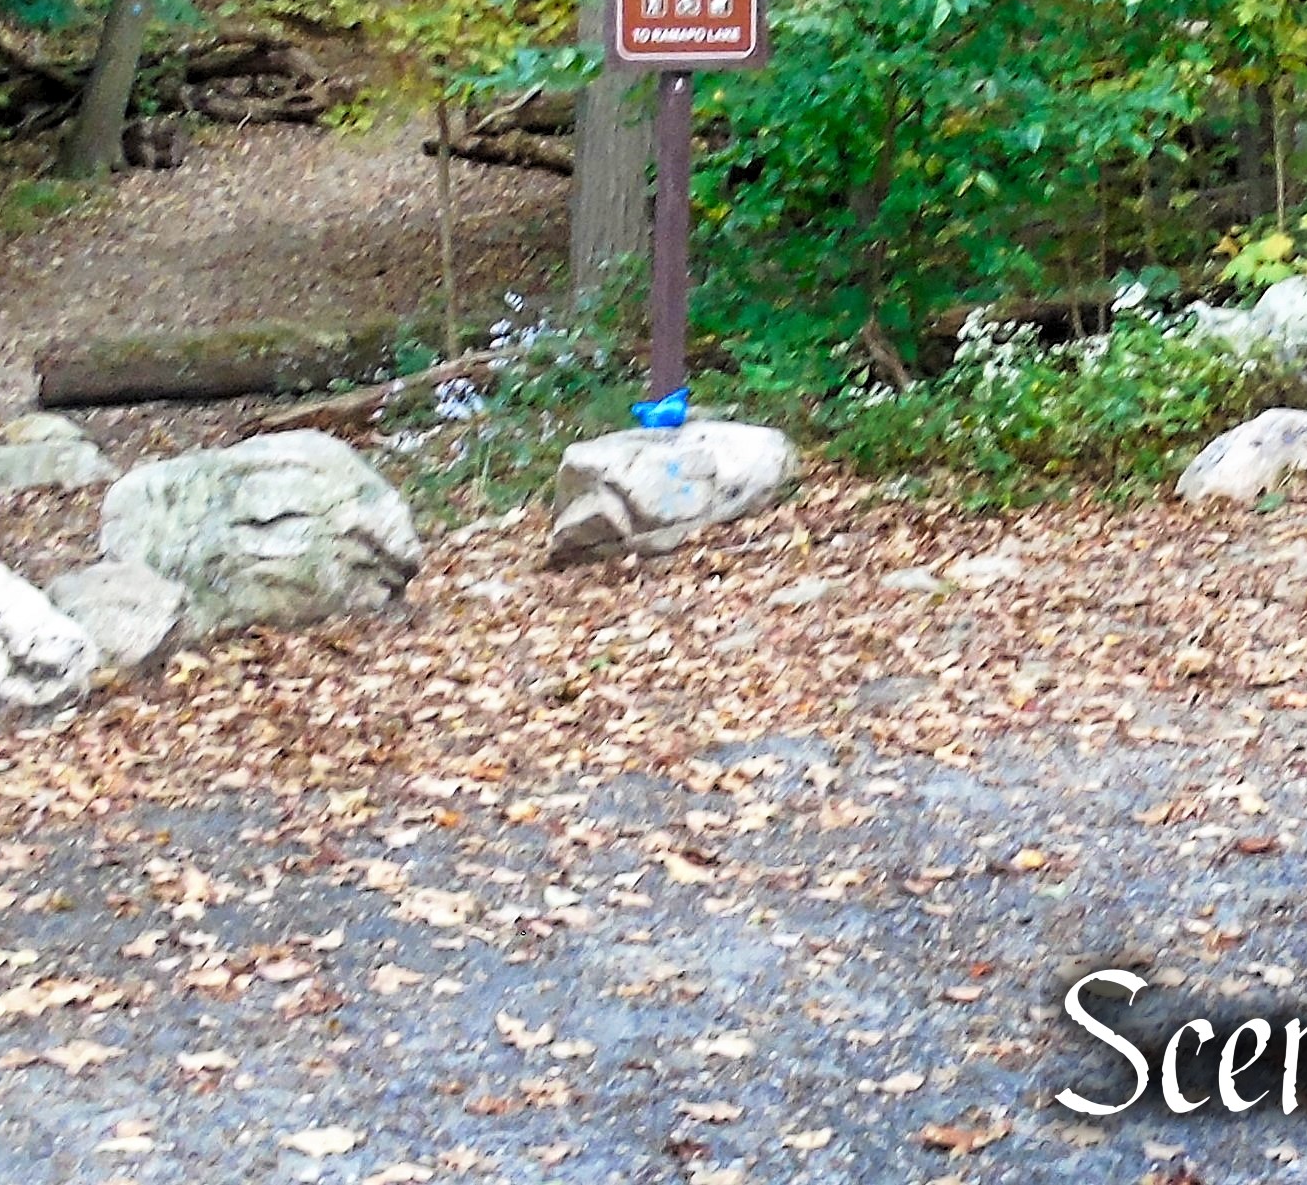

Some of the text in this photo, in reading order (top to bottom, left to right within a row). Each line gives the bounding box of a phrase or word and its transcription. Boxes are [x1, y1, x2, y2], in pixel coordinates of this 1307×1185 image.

[632, 26, 741, 44] TO RAMAPO LAKE
